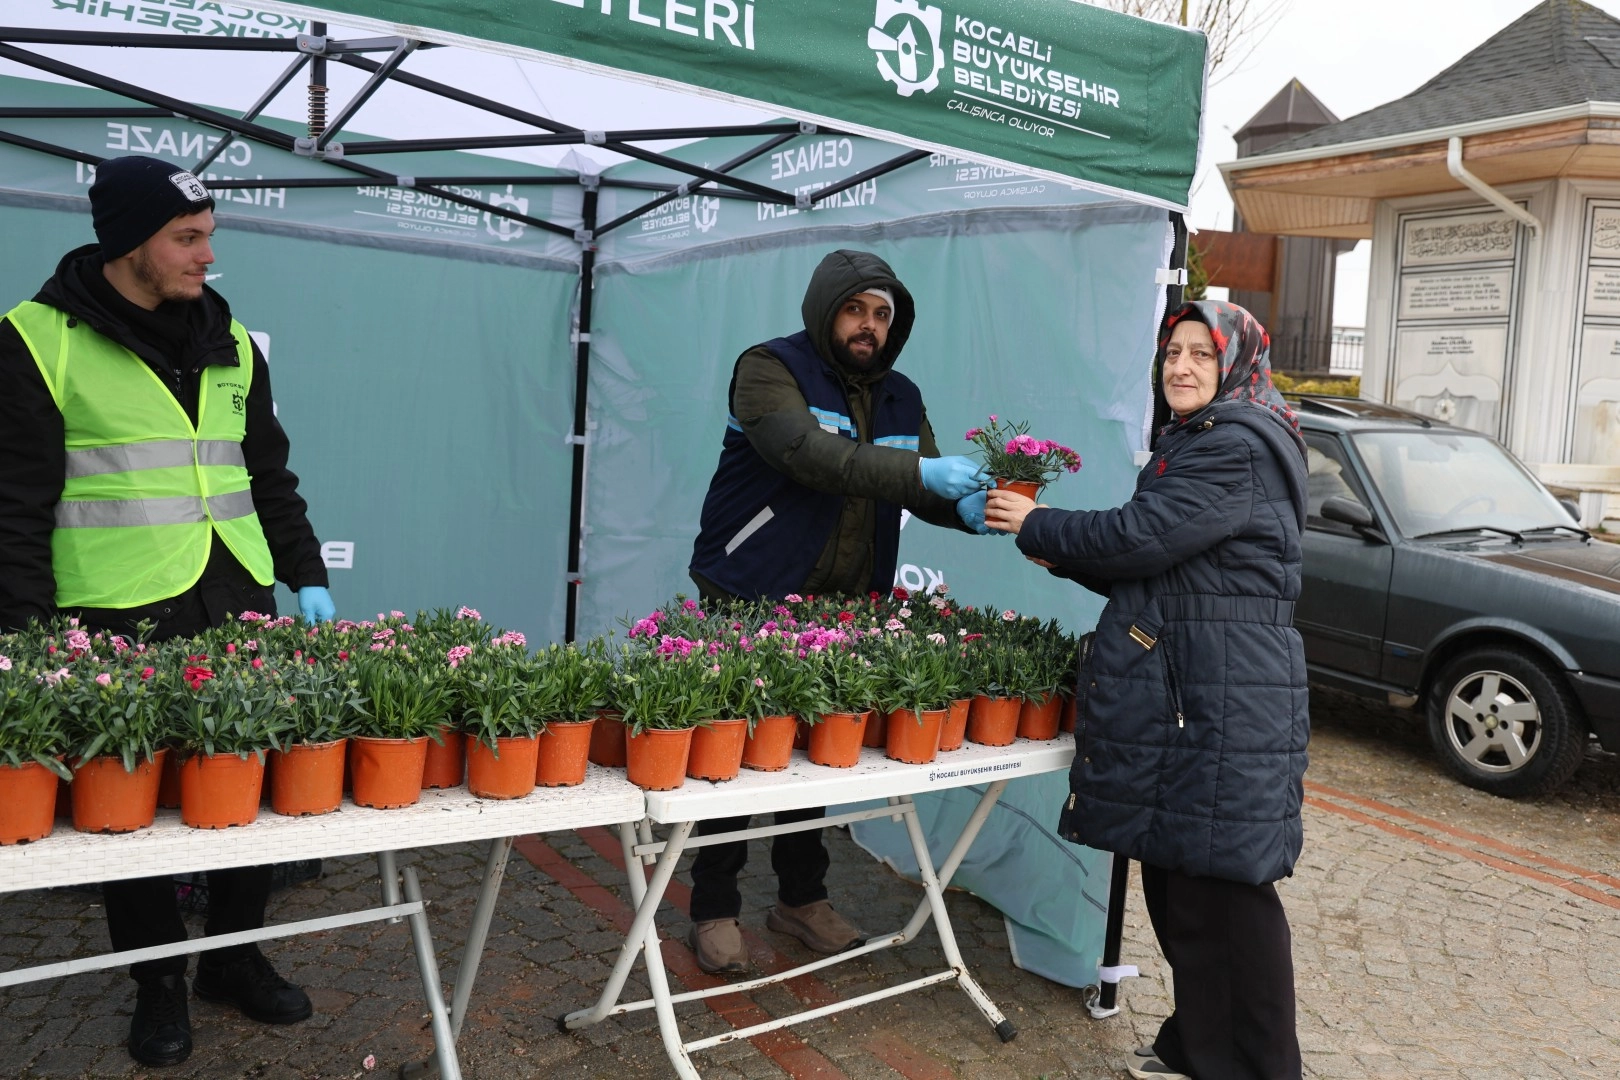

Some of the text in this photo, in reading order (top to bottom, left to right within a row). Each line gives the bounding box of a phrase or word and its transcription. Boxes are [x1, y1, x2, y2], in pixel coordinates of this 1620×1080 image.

[953, 39, 1120, 109] BÜYÜKŞEHİR
[953, 66, 1082, 120] BELEDİYESİ
[946, 99, 1055, 138] ÇALIŞINCA OLUYOR
[960, 765, 992, 777] BÜYÜKŞEHİR
[993, 761, 1022, 772] BELEDİYESİ
